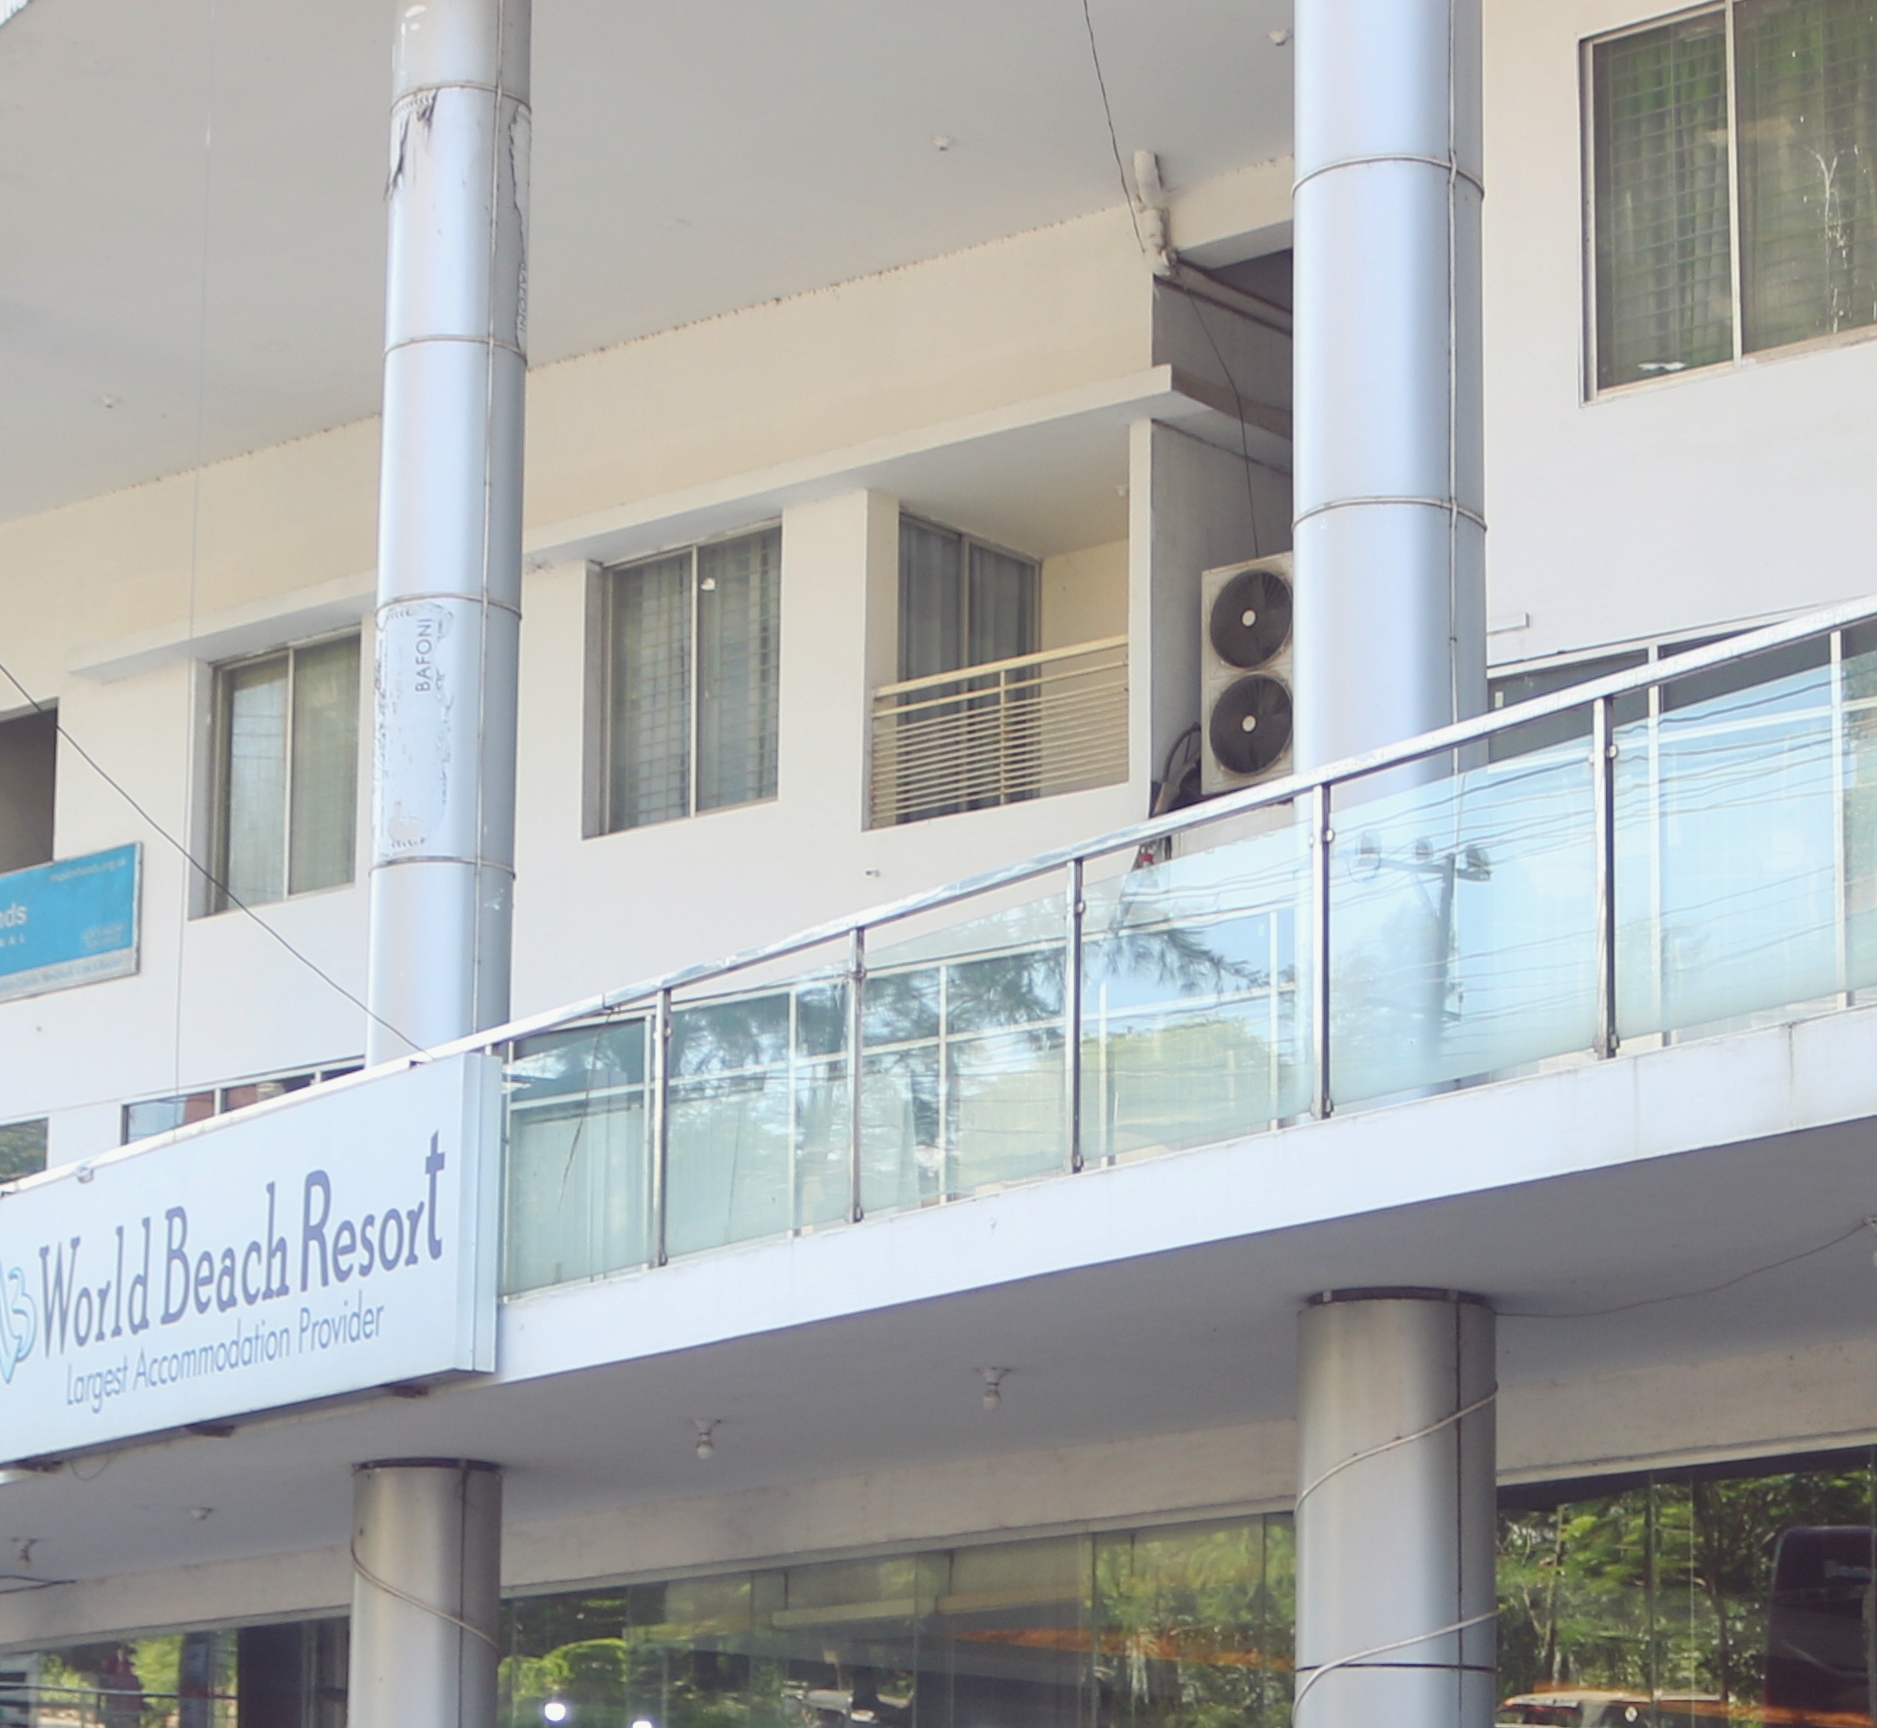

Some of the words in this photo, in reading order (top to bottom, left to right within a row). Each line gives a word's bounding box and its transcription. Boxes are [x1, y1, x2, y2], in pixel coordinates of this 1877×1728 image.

[414, 618, 433, 692] BAFONI
[38, 1216, 152, 1360] World
[160, 1181, 290, 1326] Beach
[299, 1129, 446, 1293] Resort
[65, 1354, 130, 1414] Largest
[133, 1317, 291, 1391] Accommodation
[298, 1289, 385, 1355] Provider
